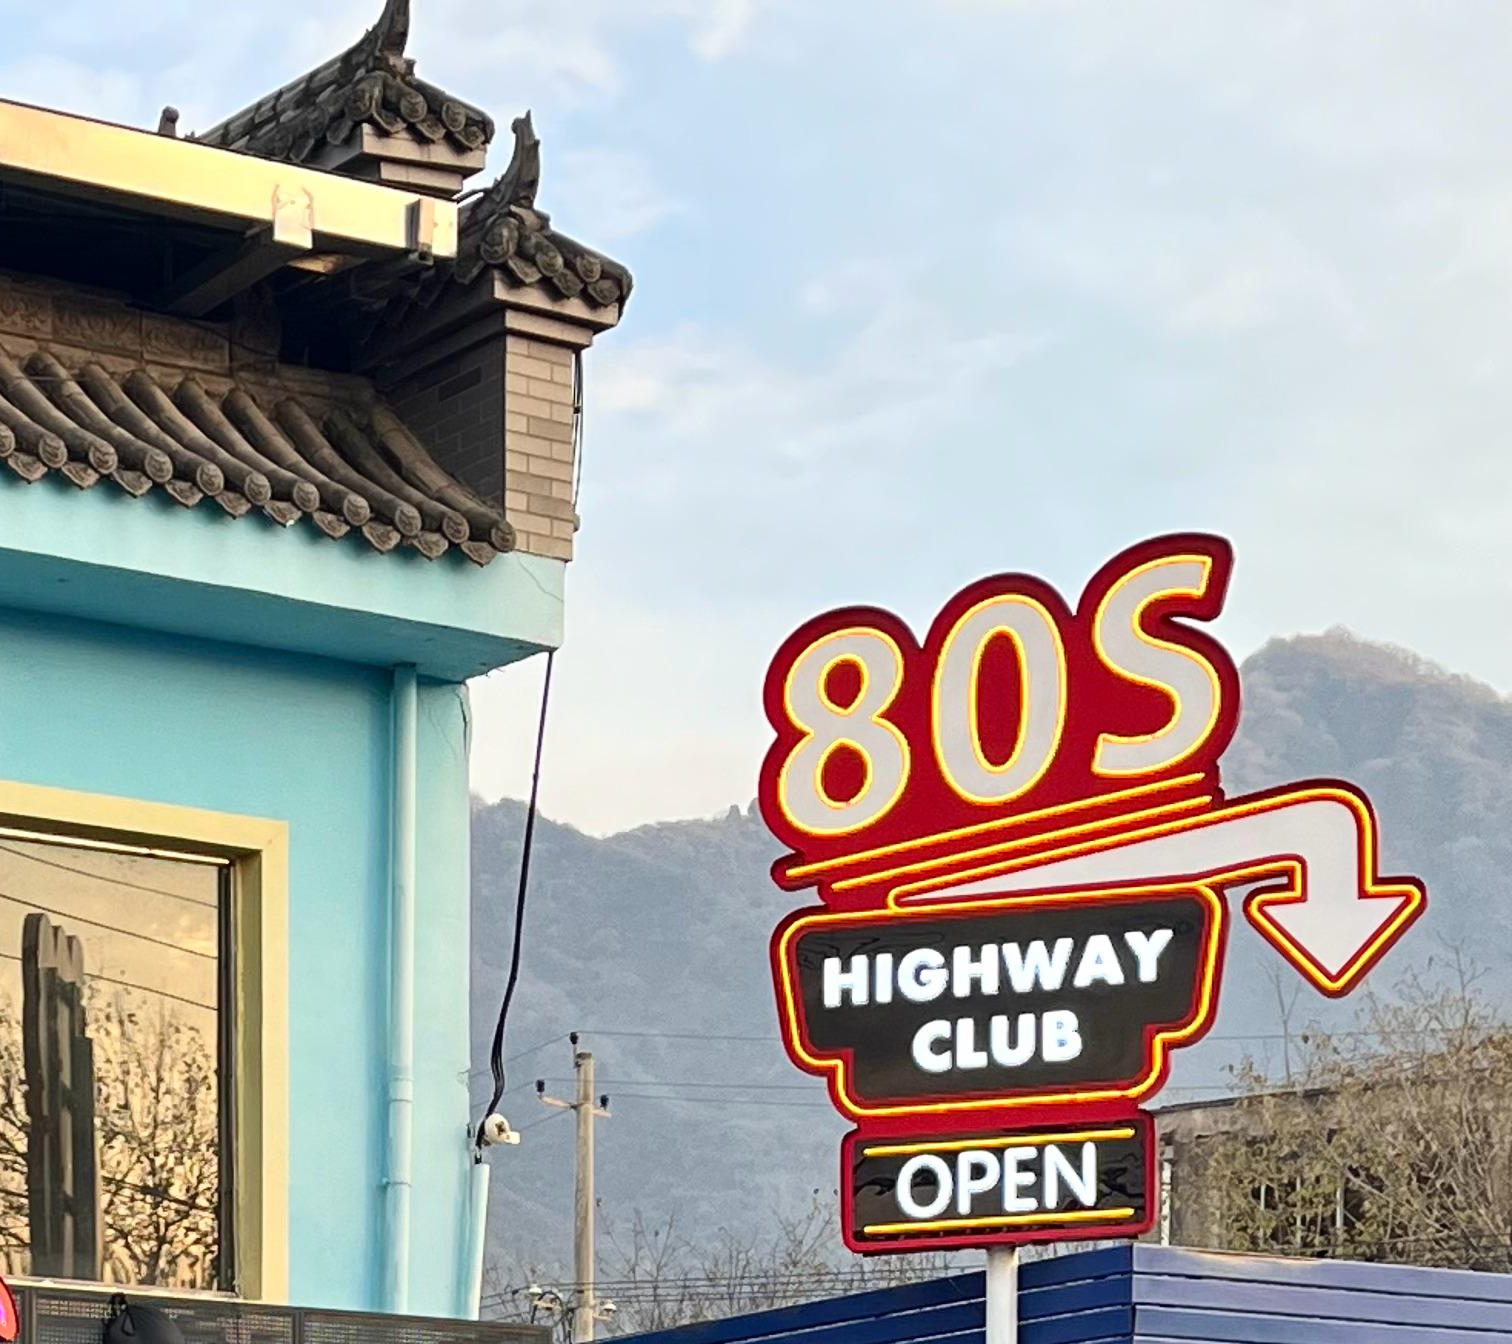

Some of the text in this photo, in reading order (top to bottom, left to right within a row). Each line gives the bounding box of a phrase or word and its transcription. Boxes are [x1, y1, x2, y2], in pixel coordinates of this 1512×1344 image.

[779, 554, 1221, 834] 80S
[823, 929, 1173, 1007] HIGHWAY
[912, 1009, 1082, 1073] CLUB
[896, 1141, 1097, 1219] OPEN
